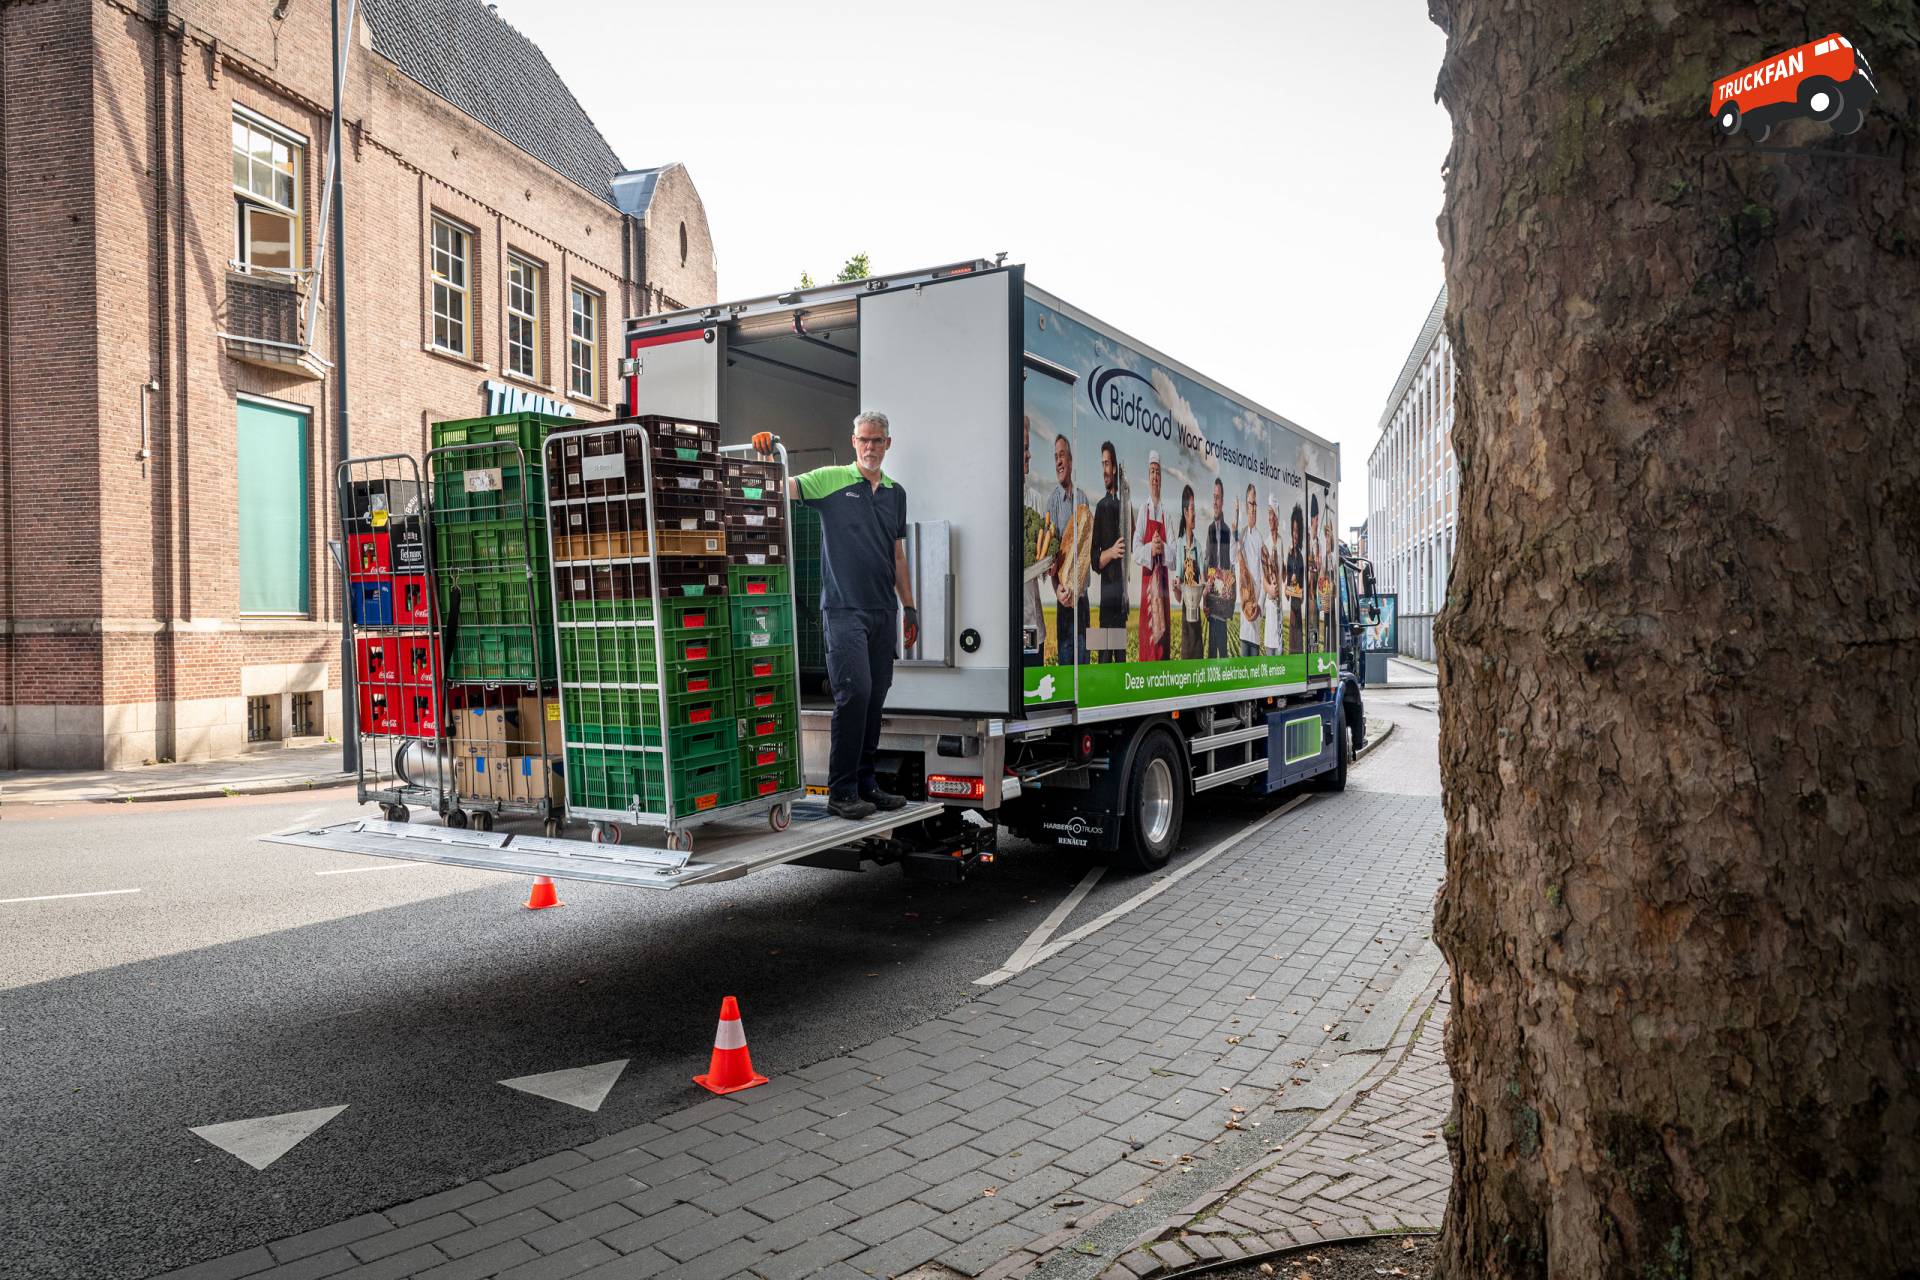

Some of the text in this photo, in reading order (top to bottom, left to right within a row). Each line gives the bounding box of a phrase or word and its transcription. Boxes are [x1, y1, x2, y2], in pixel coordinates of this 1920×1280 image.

[1110, 384, 1172, 441] Bidfood
[1177, 423, 1303, 489] Waar professionals elkaar vinden
[1125, 673, 1145, 690] Deze
[1146, 669, 1192, 690] vrachtwagen
[1192, 667, 1206, 688] rijdt
[1207, 666, 1221, 683] 100%
[1250, 663, 1261, 679] met
[1261, 663, 1269, 678] 0%
[1269, 663, 1286, 677] emissie
[1043, 822, 1104, 834] HARBERS TRUCKS
[1058, 837, 1088, 847] RENAULT
